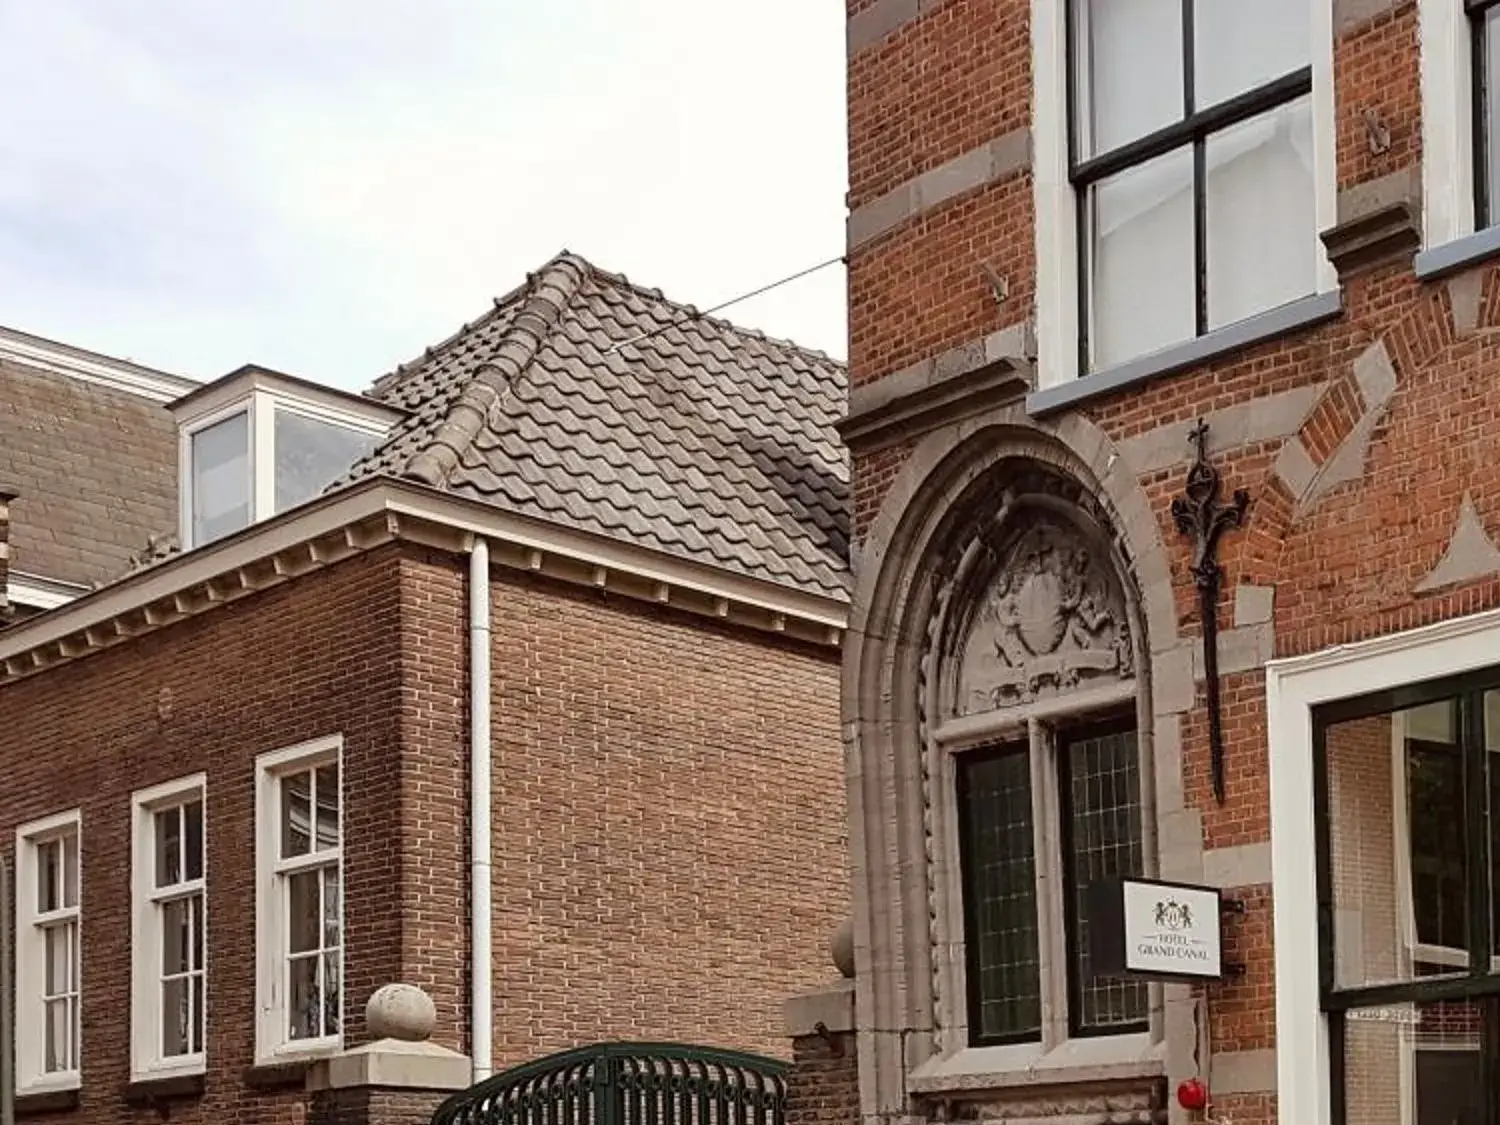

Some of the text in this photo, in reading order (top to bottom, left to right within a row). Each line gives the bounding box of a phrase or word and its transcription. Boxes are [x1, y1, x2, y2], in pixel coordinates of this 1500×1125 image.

[1159, 933, 1189, 946] HOTEL
[1137, 943, 1210, 960] GRAND CANAL
